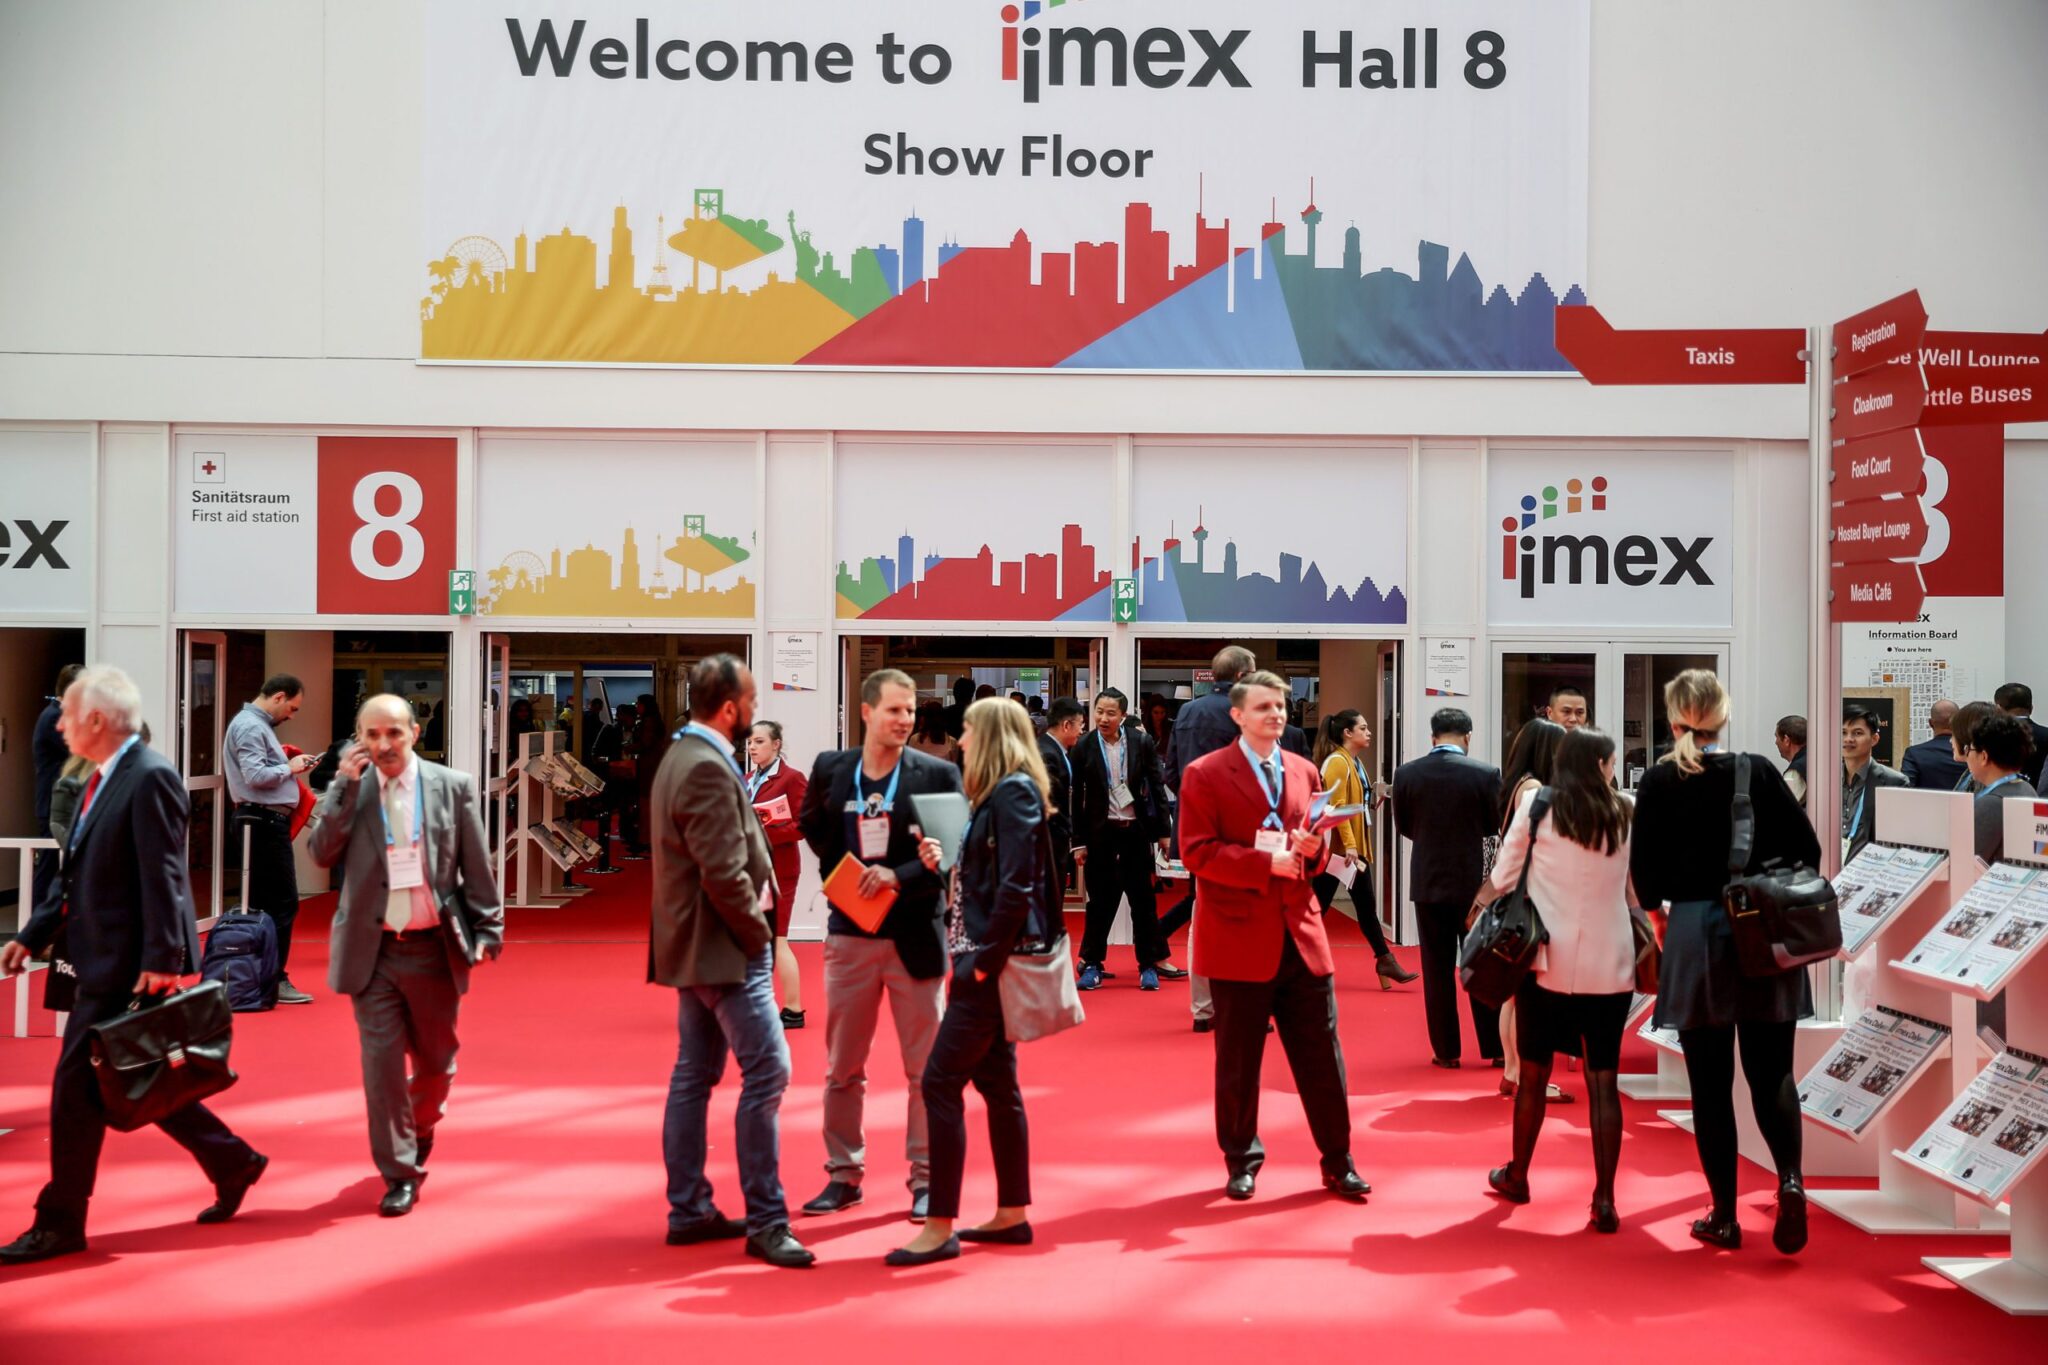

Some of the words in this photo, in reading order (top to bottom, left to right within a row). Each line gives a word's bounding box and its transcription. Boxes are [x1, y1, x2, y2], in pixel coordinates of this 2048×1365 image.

[505, 18, 854, 84] Welcome
[876, 33, 952, 85] to
[1002, 5, 1251, 103] imex
[1302, 27, 1438, 89] Hall
[1463, 30, 1507, 90] 8
[864, 132, 1004, 176] Show
[1021, 134, 1153, 178] Floor
[1852, 322, 1896, 352] Registration
[1685, 347, 1736, 366] Taxis
[1887, 352, 1911, 364] e
[1918, 349, 1961, 366] Well
[1853, 392, 1893, 415] Cloakroom
[1971, 386, 2032, 405] Buses
[1851, 460, 1869, 479] Food
[1870, 456, 1891, 475] Court
[192, 490, 290, 504] Sanitätsraum
[192, 509, 222, 522] First
[226, 510, 247, 522] aid
[252, 510, 299, 523] station
[350, 471, 425, 581] 8
[1838, 522, 1861, 542] Hosted
[1862, 522, 1882, 543] Buyer
[1883, 520, 1910, 540] Lounge
[0, 519, 71, 570] x
[1502, 517, 1714, 598] imex
[1850, 584, 1873, 601] Media
[1874, 582, 1892, 601] Café
[1868, 630, 1926, 639] Information
[1929, 630, 1958, 639] Board
